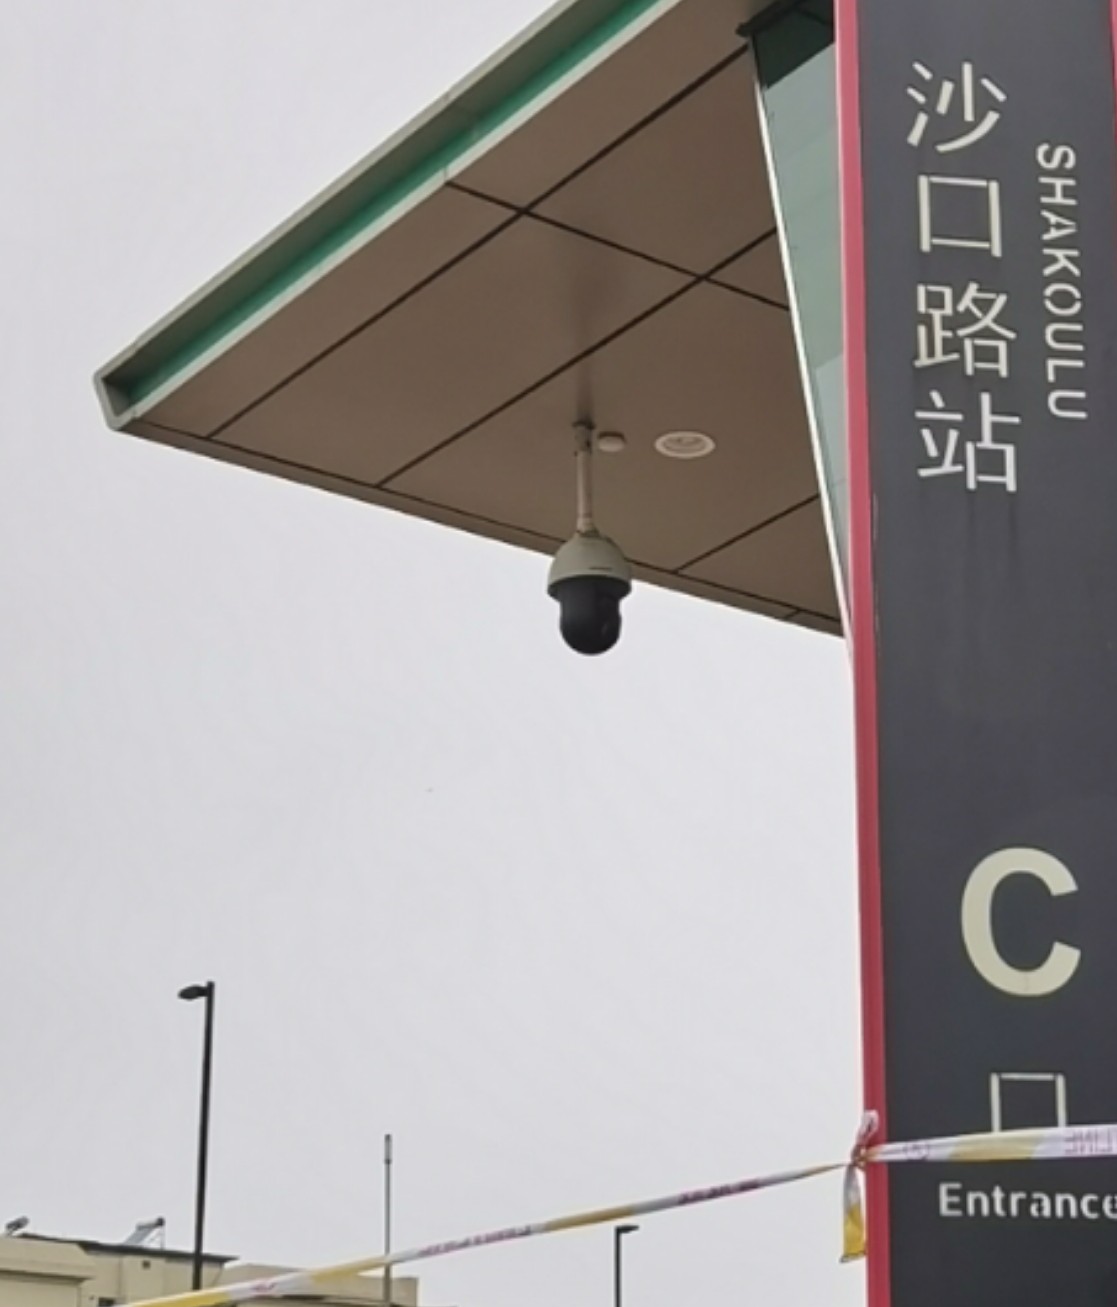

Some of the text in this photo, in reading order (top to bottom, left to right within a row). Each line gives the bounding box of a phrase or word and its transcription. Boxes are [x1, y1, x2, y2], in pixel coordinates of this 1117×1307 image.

[906, 61, 1021, 492] 沙口路站
[1036, 143, 1088, 419] SHAKOULU
[961, 847, 1081, 996] C
